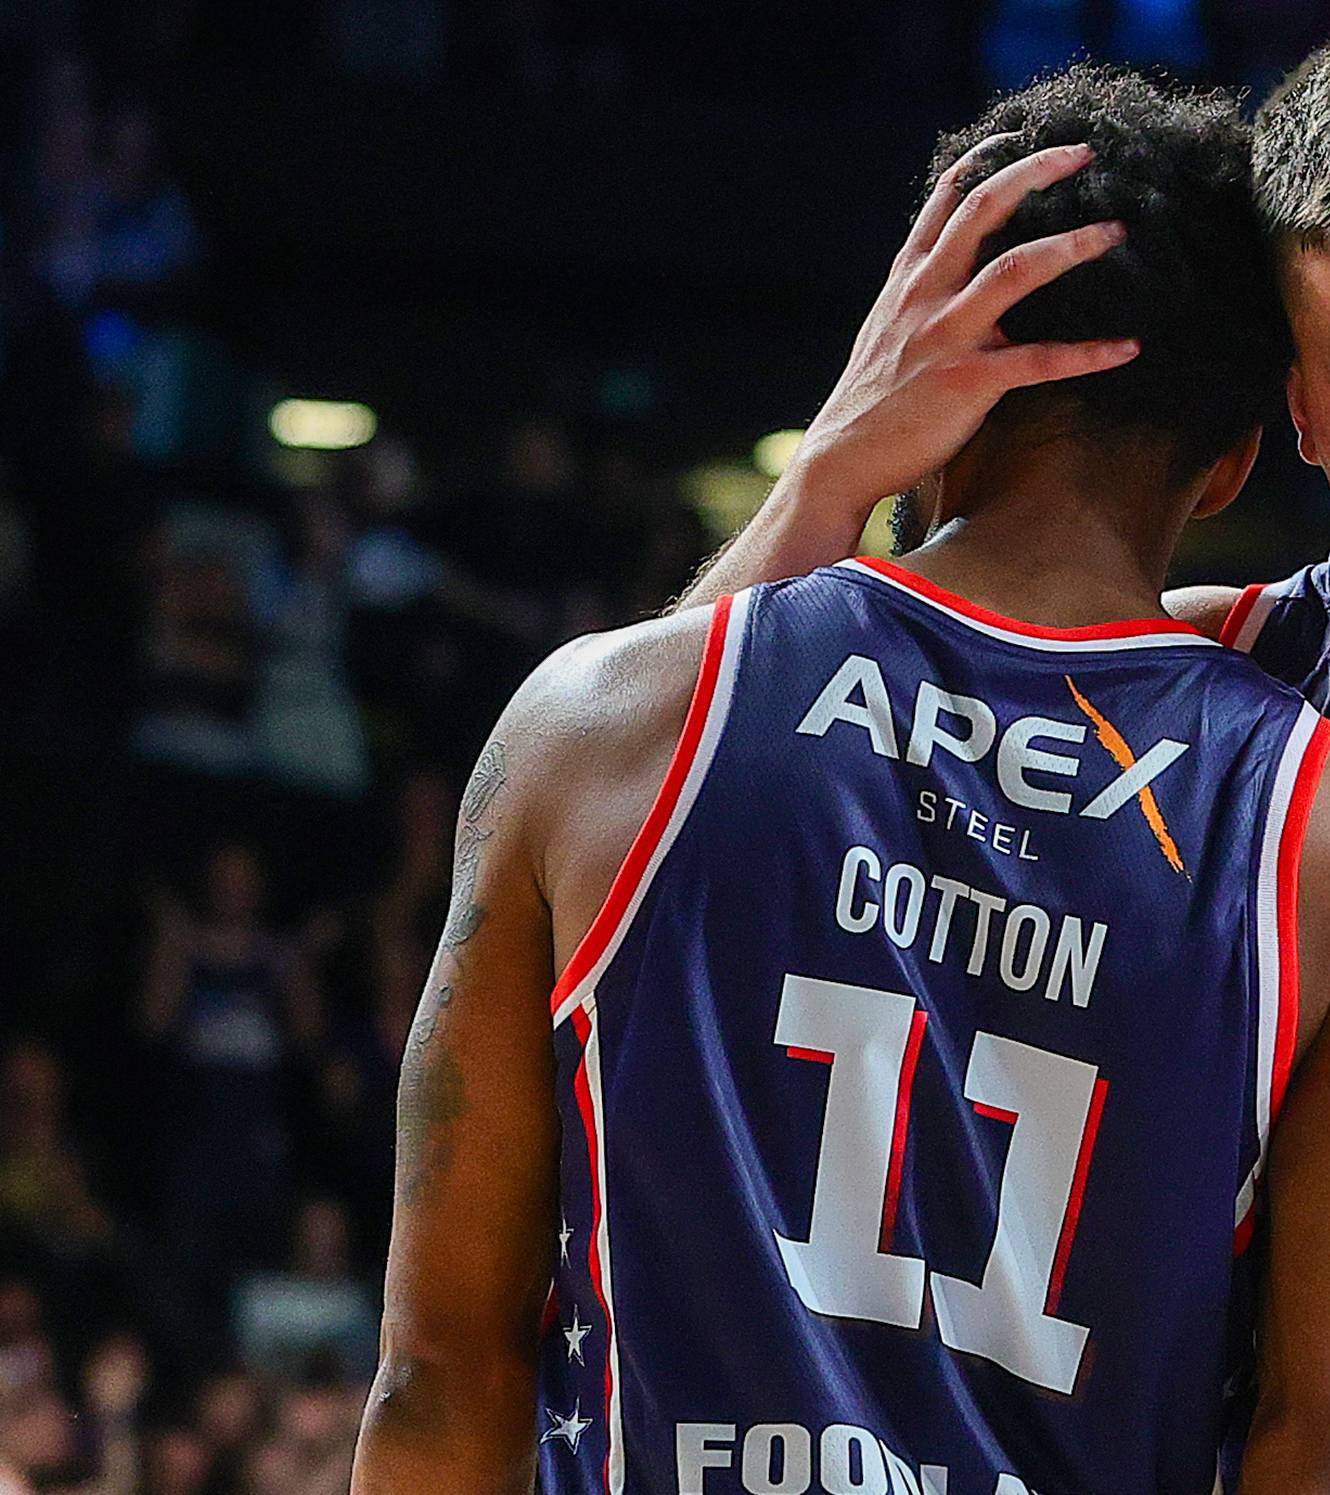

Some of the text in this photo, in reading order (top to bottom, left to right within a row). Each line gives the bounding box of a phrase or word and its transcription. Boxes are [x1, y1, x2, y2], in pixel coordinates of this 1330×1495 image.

[795, 654, 1192, 880] APEX
[916, 790, 1039, 861] STEEL
[835, 845, 1108, 1008] COTTON
[773, 973, 1109, 1396] 11
